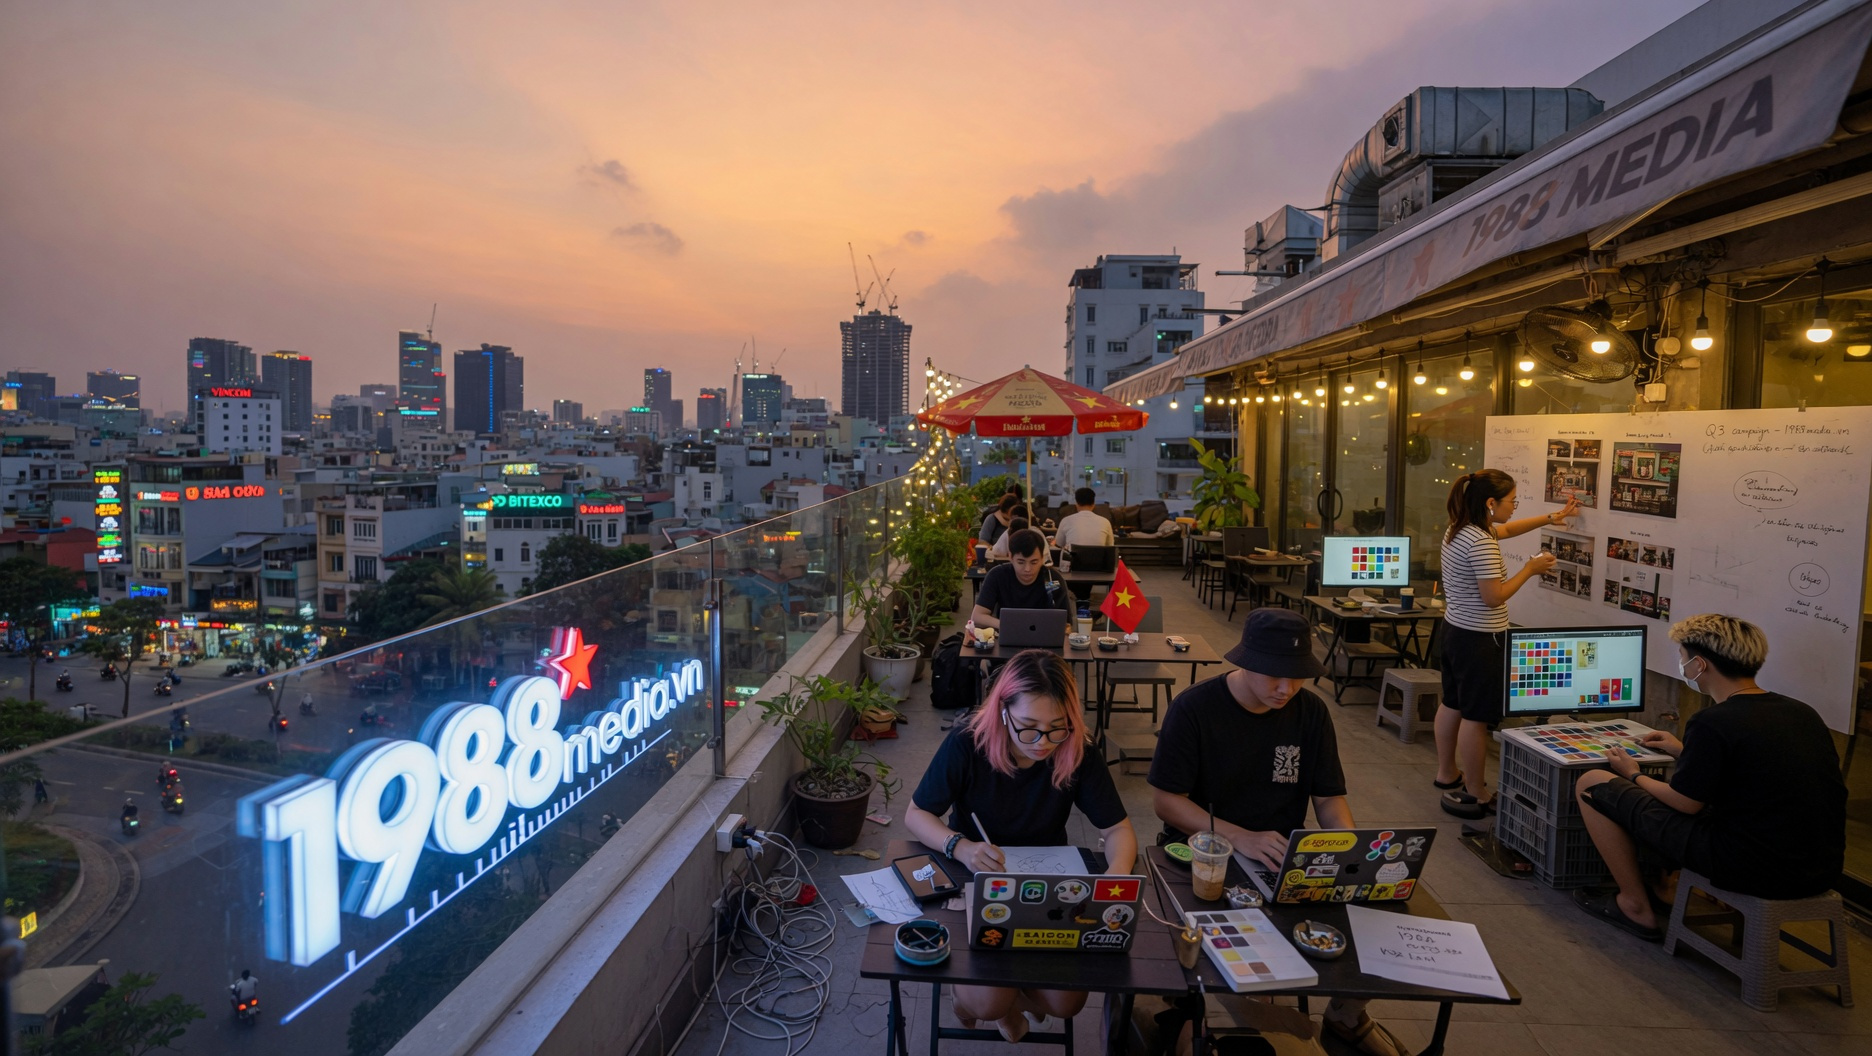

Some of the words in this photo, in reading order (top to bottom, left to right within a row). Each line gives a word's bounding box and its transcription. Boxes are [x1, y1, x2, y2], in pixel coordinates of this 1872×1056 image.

[1461, 179, 1562, 259] 1988
[1556, 74, 1774, 219] MEDIA
[1705, 423, 1725, 440] Q3
[1731, 426, 1770, 443] campaign
[508, 494, 562, 508] BITEXCO
